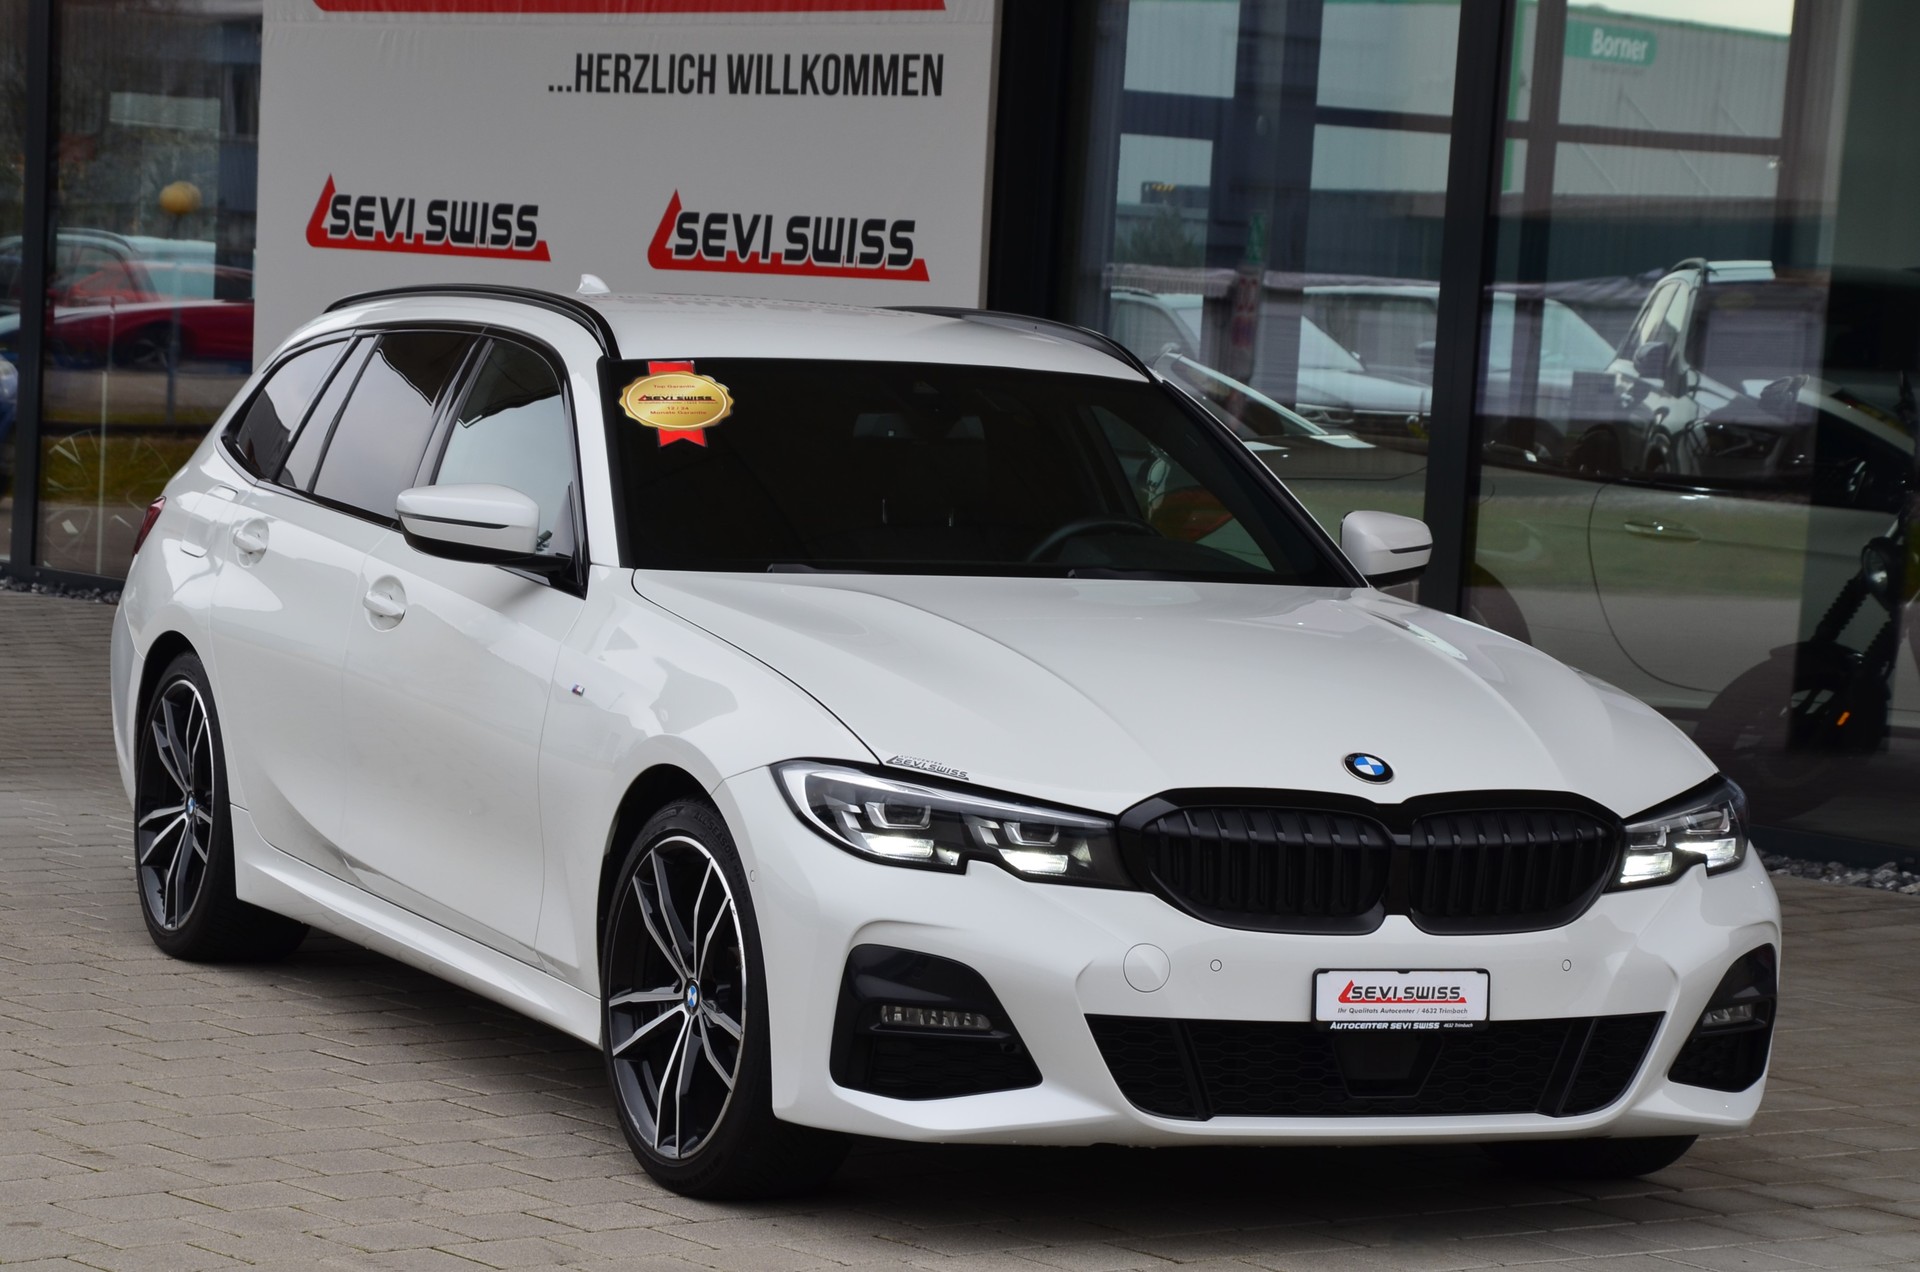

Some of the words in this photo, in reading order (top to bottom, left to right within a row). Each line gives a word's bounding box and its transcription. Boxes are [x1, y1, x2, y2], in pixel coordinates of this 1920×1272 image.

[1591, 27, 1649, 61] Borner
[726, 53, 944, 97] WILLKOMMEN
[329, 193, 416, 241] SEVI
[424, 199, 539, 248] SWISS
[673, 211, 774, 262] SEVI
[783, 215, 916, 267] SWISS
[895, 757, 926, 769] SEVI
[927, 763, 968, 777] SWISS
[693, 811, 708, 826] ALL
[707, 821, 735, 861] SEASON
[1351, 986, 1398, 1000] SEVI
[1403, 986, 1461, 1000] SWISS
[1389, 1022, 1412, 1030] SEVI
[1412, 1022, 1440, 1030] SWISS
